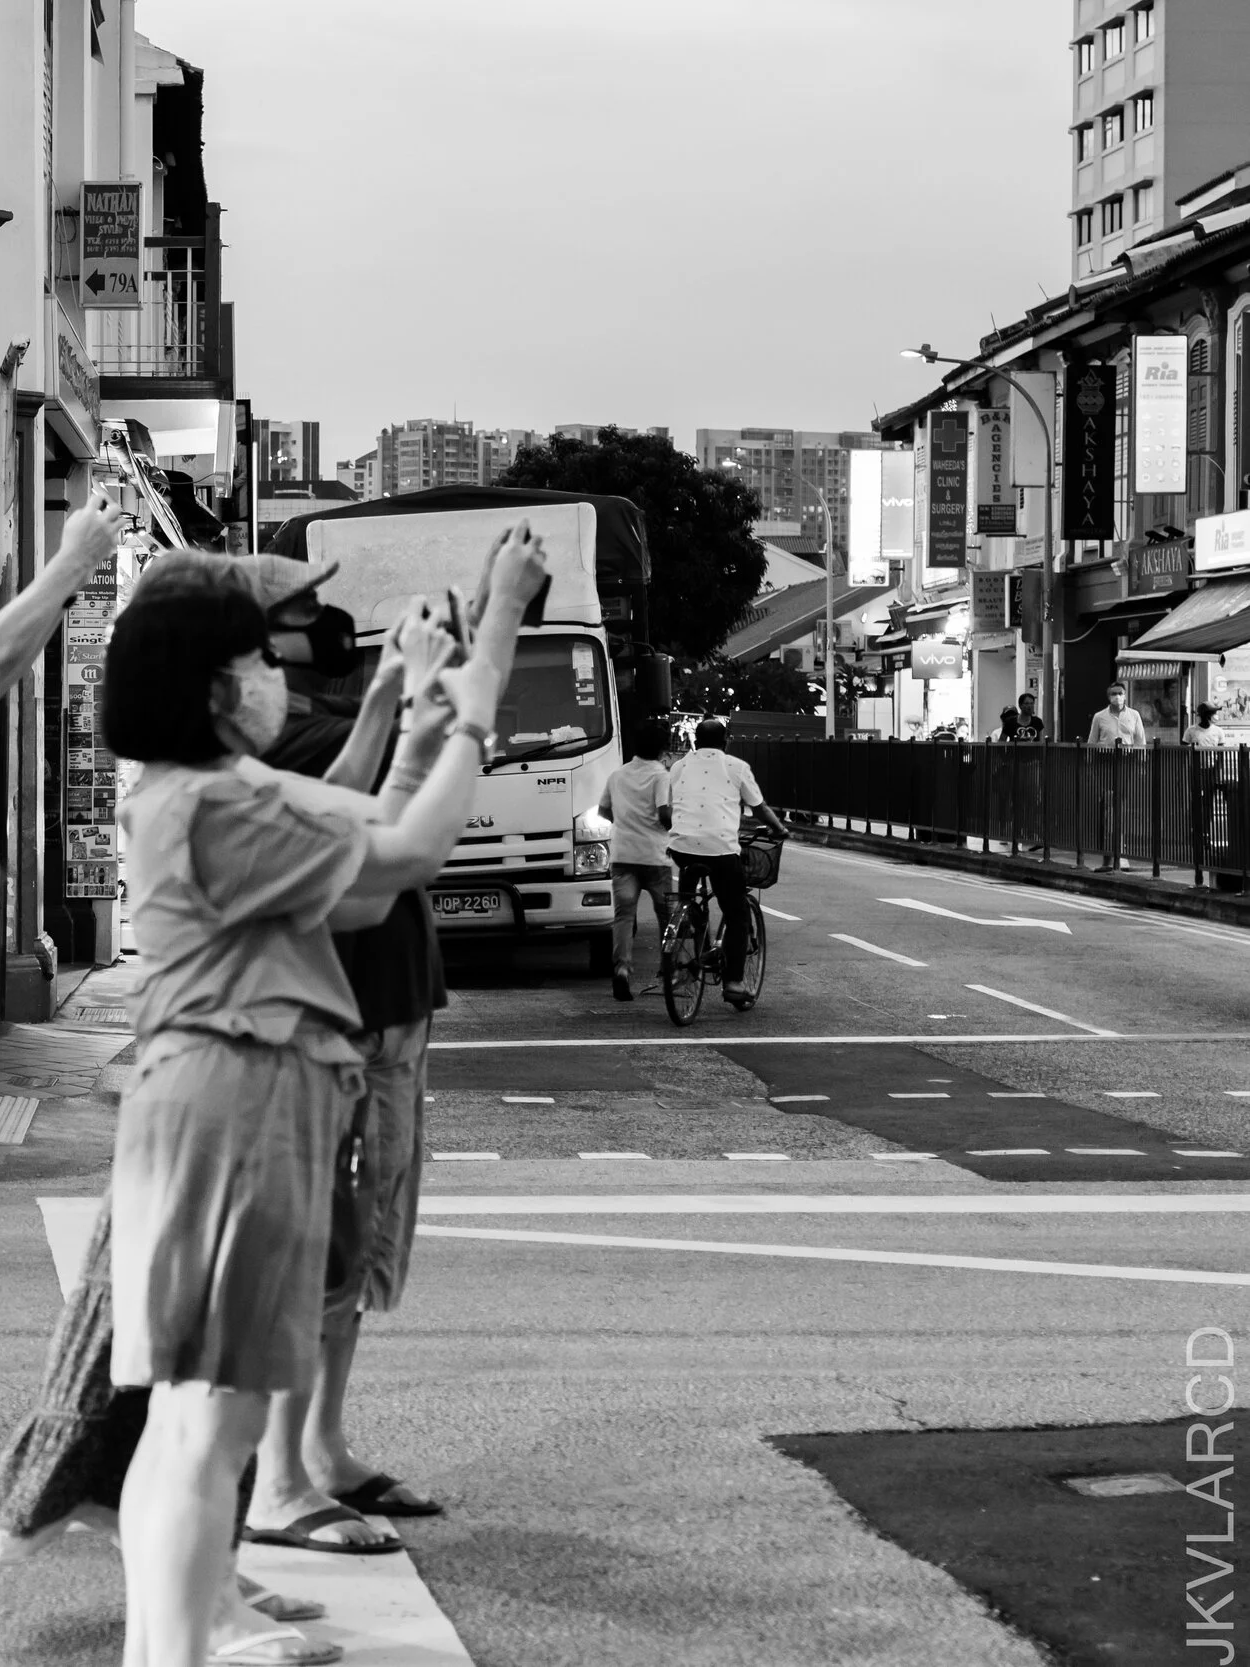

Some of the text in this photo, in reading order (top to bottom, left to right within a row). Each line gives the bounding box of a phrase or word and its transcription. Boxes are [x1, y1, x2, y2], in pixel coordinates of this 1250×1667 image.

[87, 191, 138, 212] NATHAN
[109, 272, 138, 293] 79A
[1145, 361, 1178, 380] Ria
[933, 459, 966, 472] WAHEEDA'S
[991, 424, 1002, 503] AGENCIES
[1081, 416, 1097, 526] AKSHAYA
[936, 476, 961, 488] CLINIC
[882, 496, 913, 507] vivo
[945, 489, 952, 501] &
[931, 503, 966, 515] SURGERY
[1214, 519, 1230, 552] Ria
[1141, 546, 1183, 576] AKSHAYA
[69, 636, 104, 644] Singt
[919, 652, 956, 665] vivo
[537, 777, 567, 786] NPR
[464, 895, 499, 910] 2260
